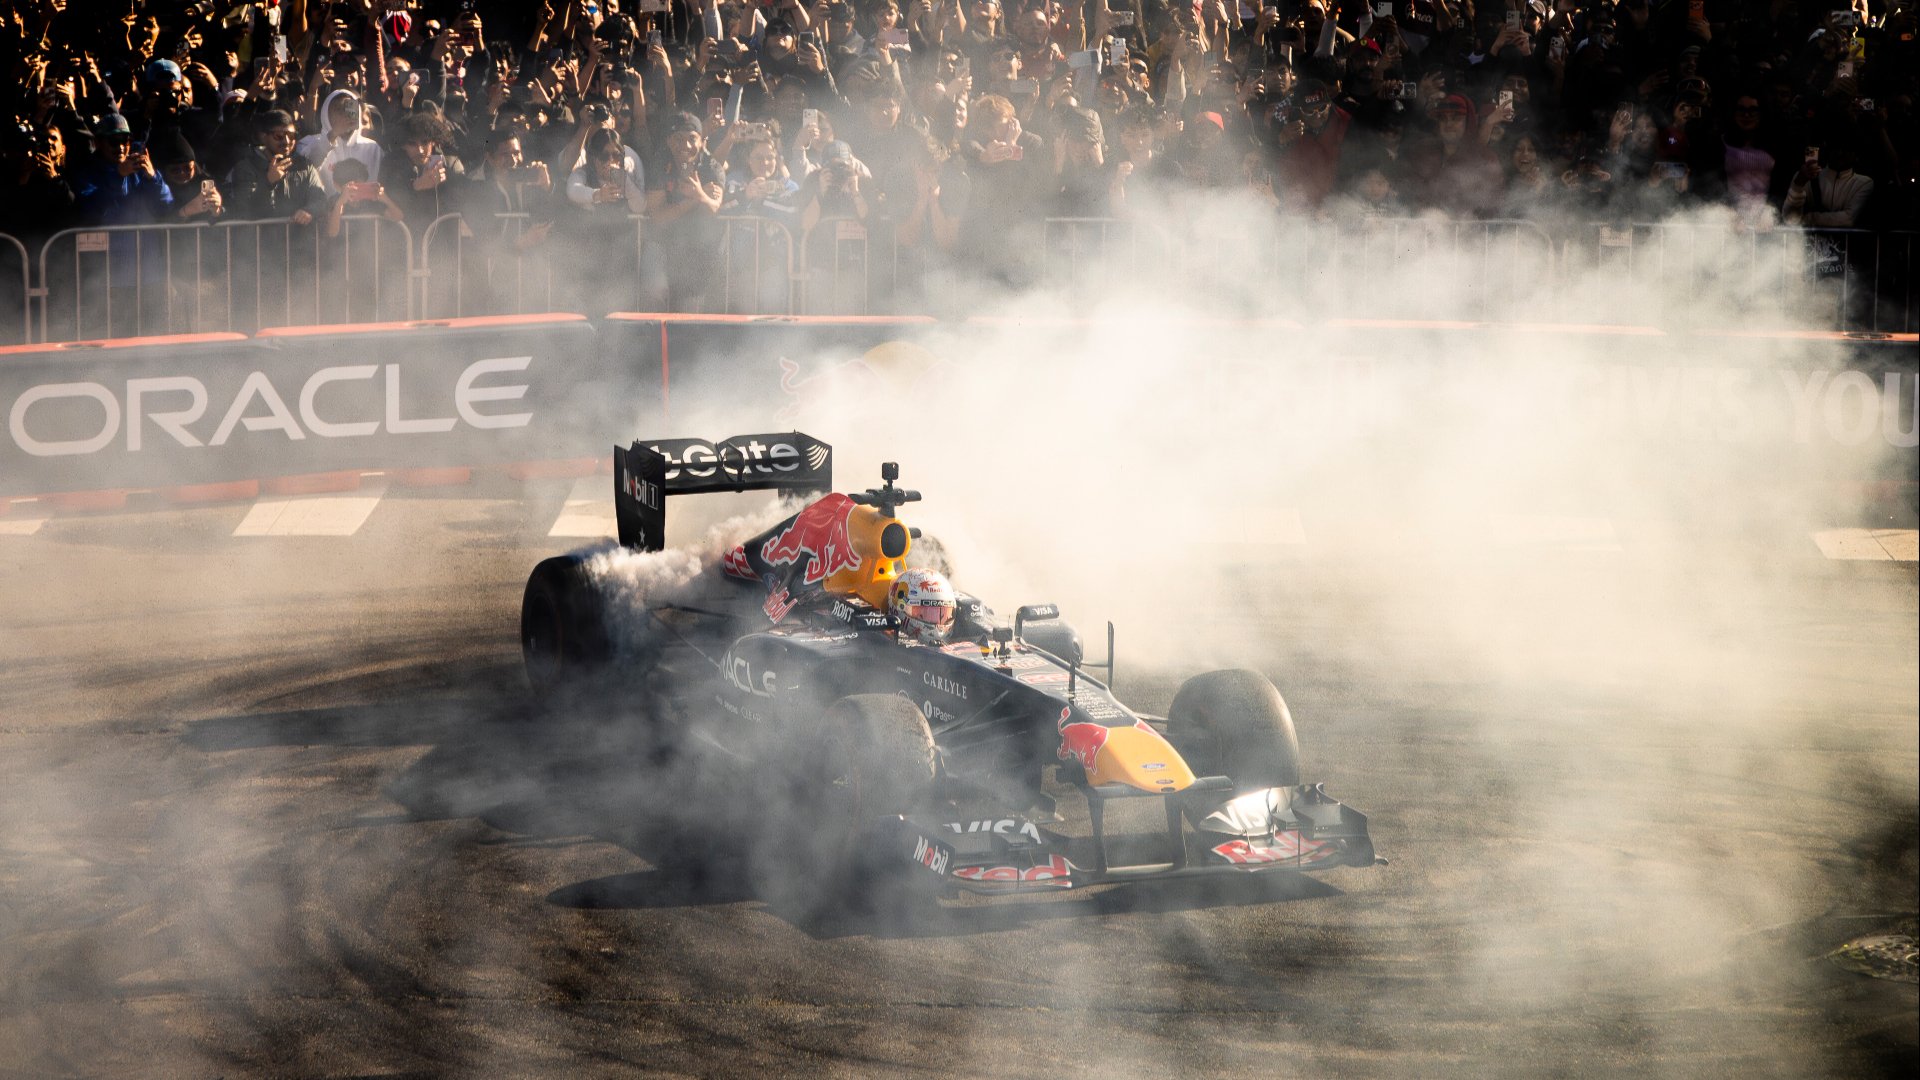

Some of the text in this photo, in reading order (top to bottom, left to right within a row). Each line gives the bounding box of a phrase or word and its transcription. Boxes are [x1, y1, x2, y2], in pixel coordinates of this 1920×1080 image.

[9, 356, 533, 456] ORACLE
[1779, 369, 1919, 448] YOU
[864, 618, 888, 626] VISA
[923, 671, 968, 700] CARLYLE
[913, 835, 949, 875] Mobil
